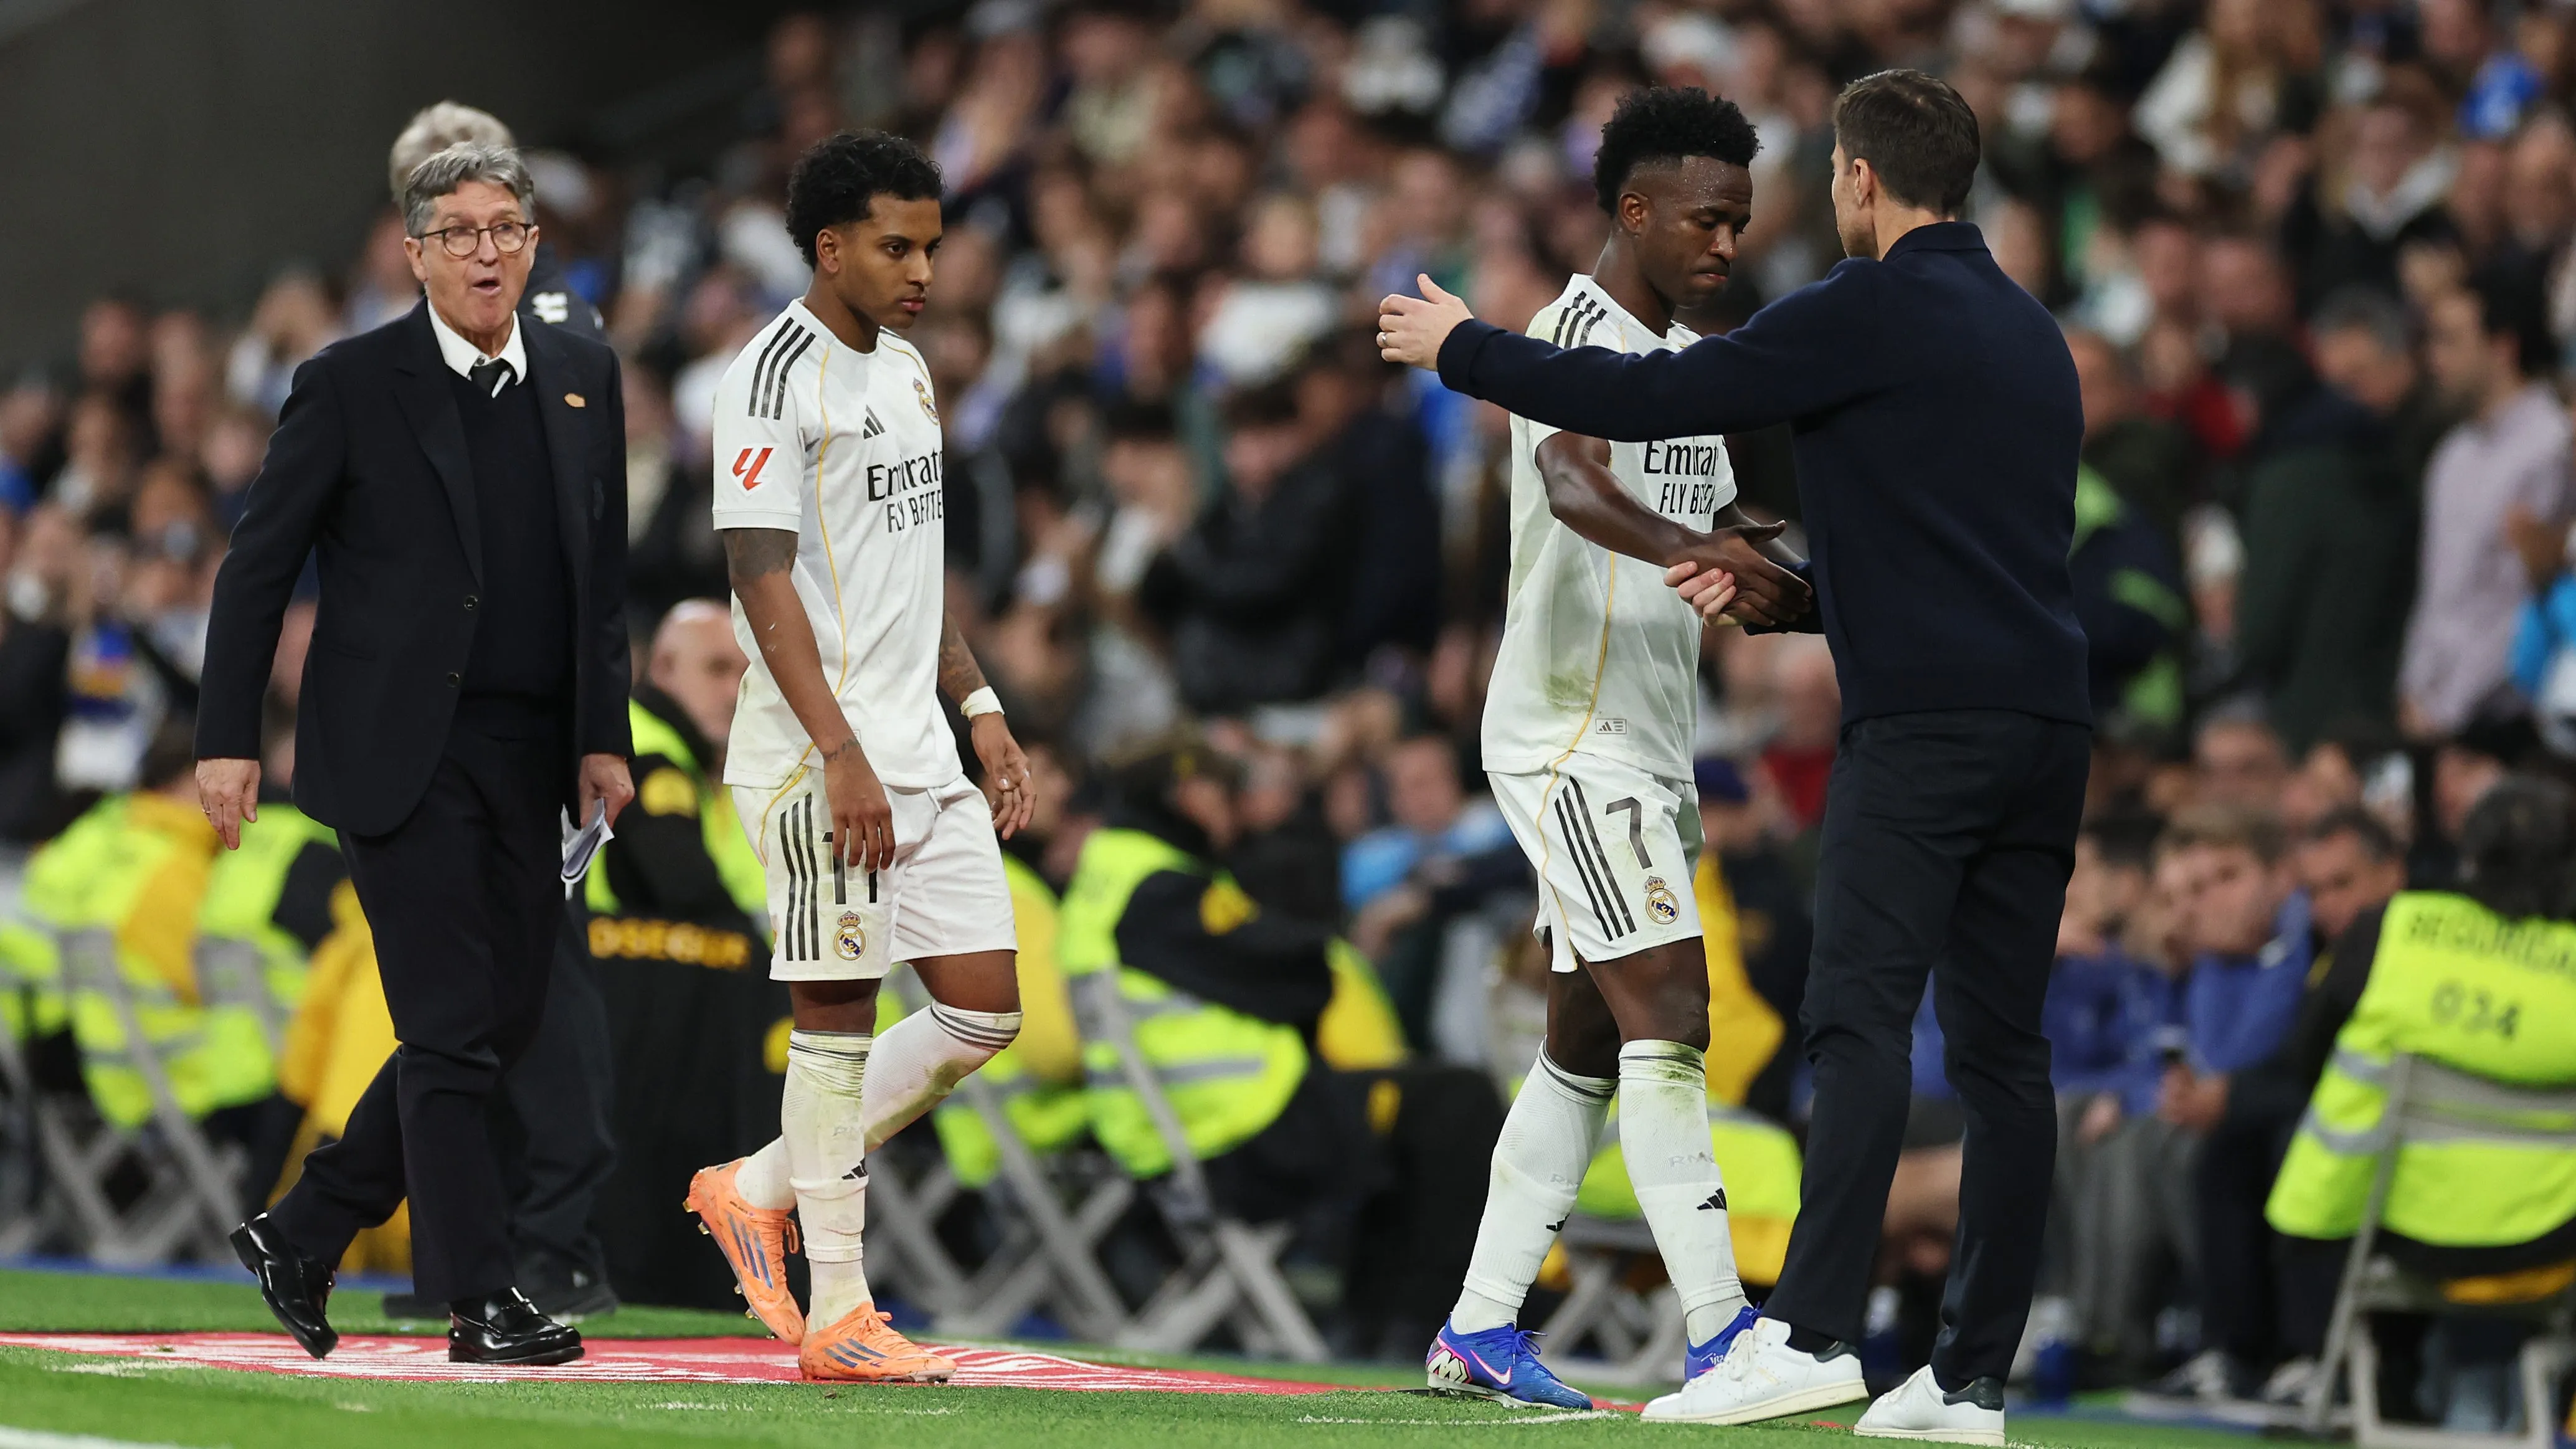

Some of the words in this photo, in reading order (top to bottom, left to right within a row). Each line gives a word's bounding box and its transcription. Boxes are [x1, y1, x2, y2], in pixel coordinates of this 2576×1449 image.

[1644, 437, 1719, 476] Emirat
[1659, 483, 1687, 513] FLY
[1606, 796, 1653, 870] 7
